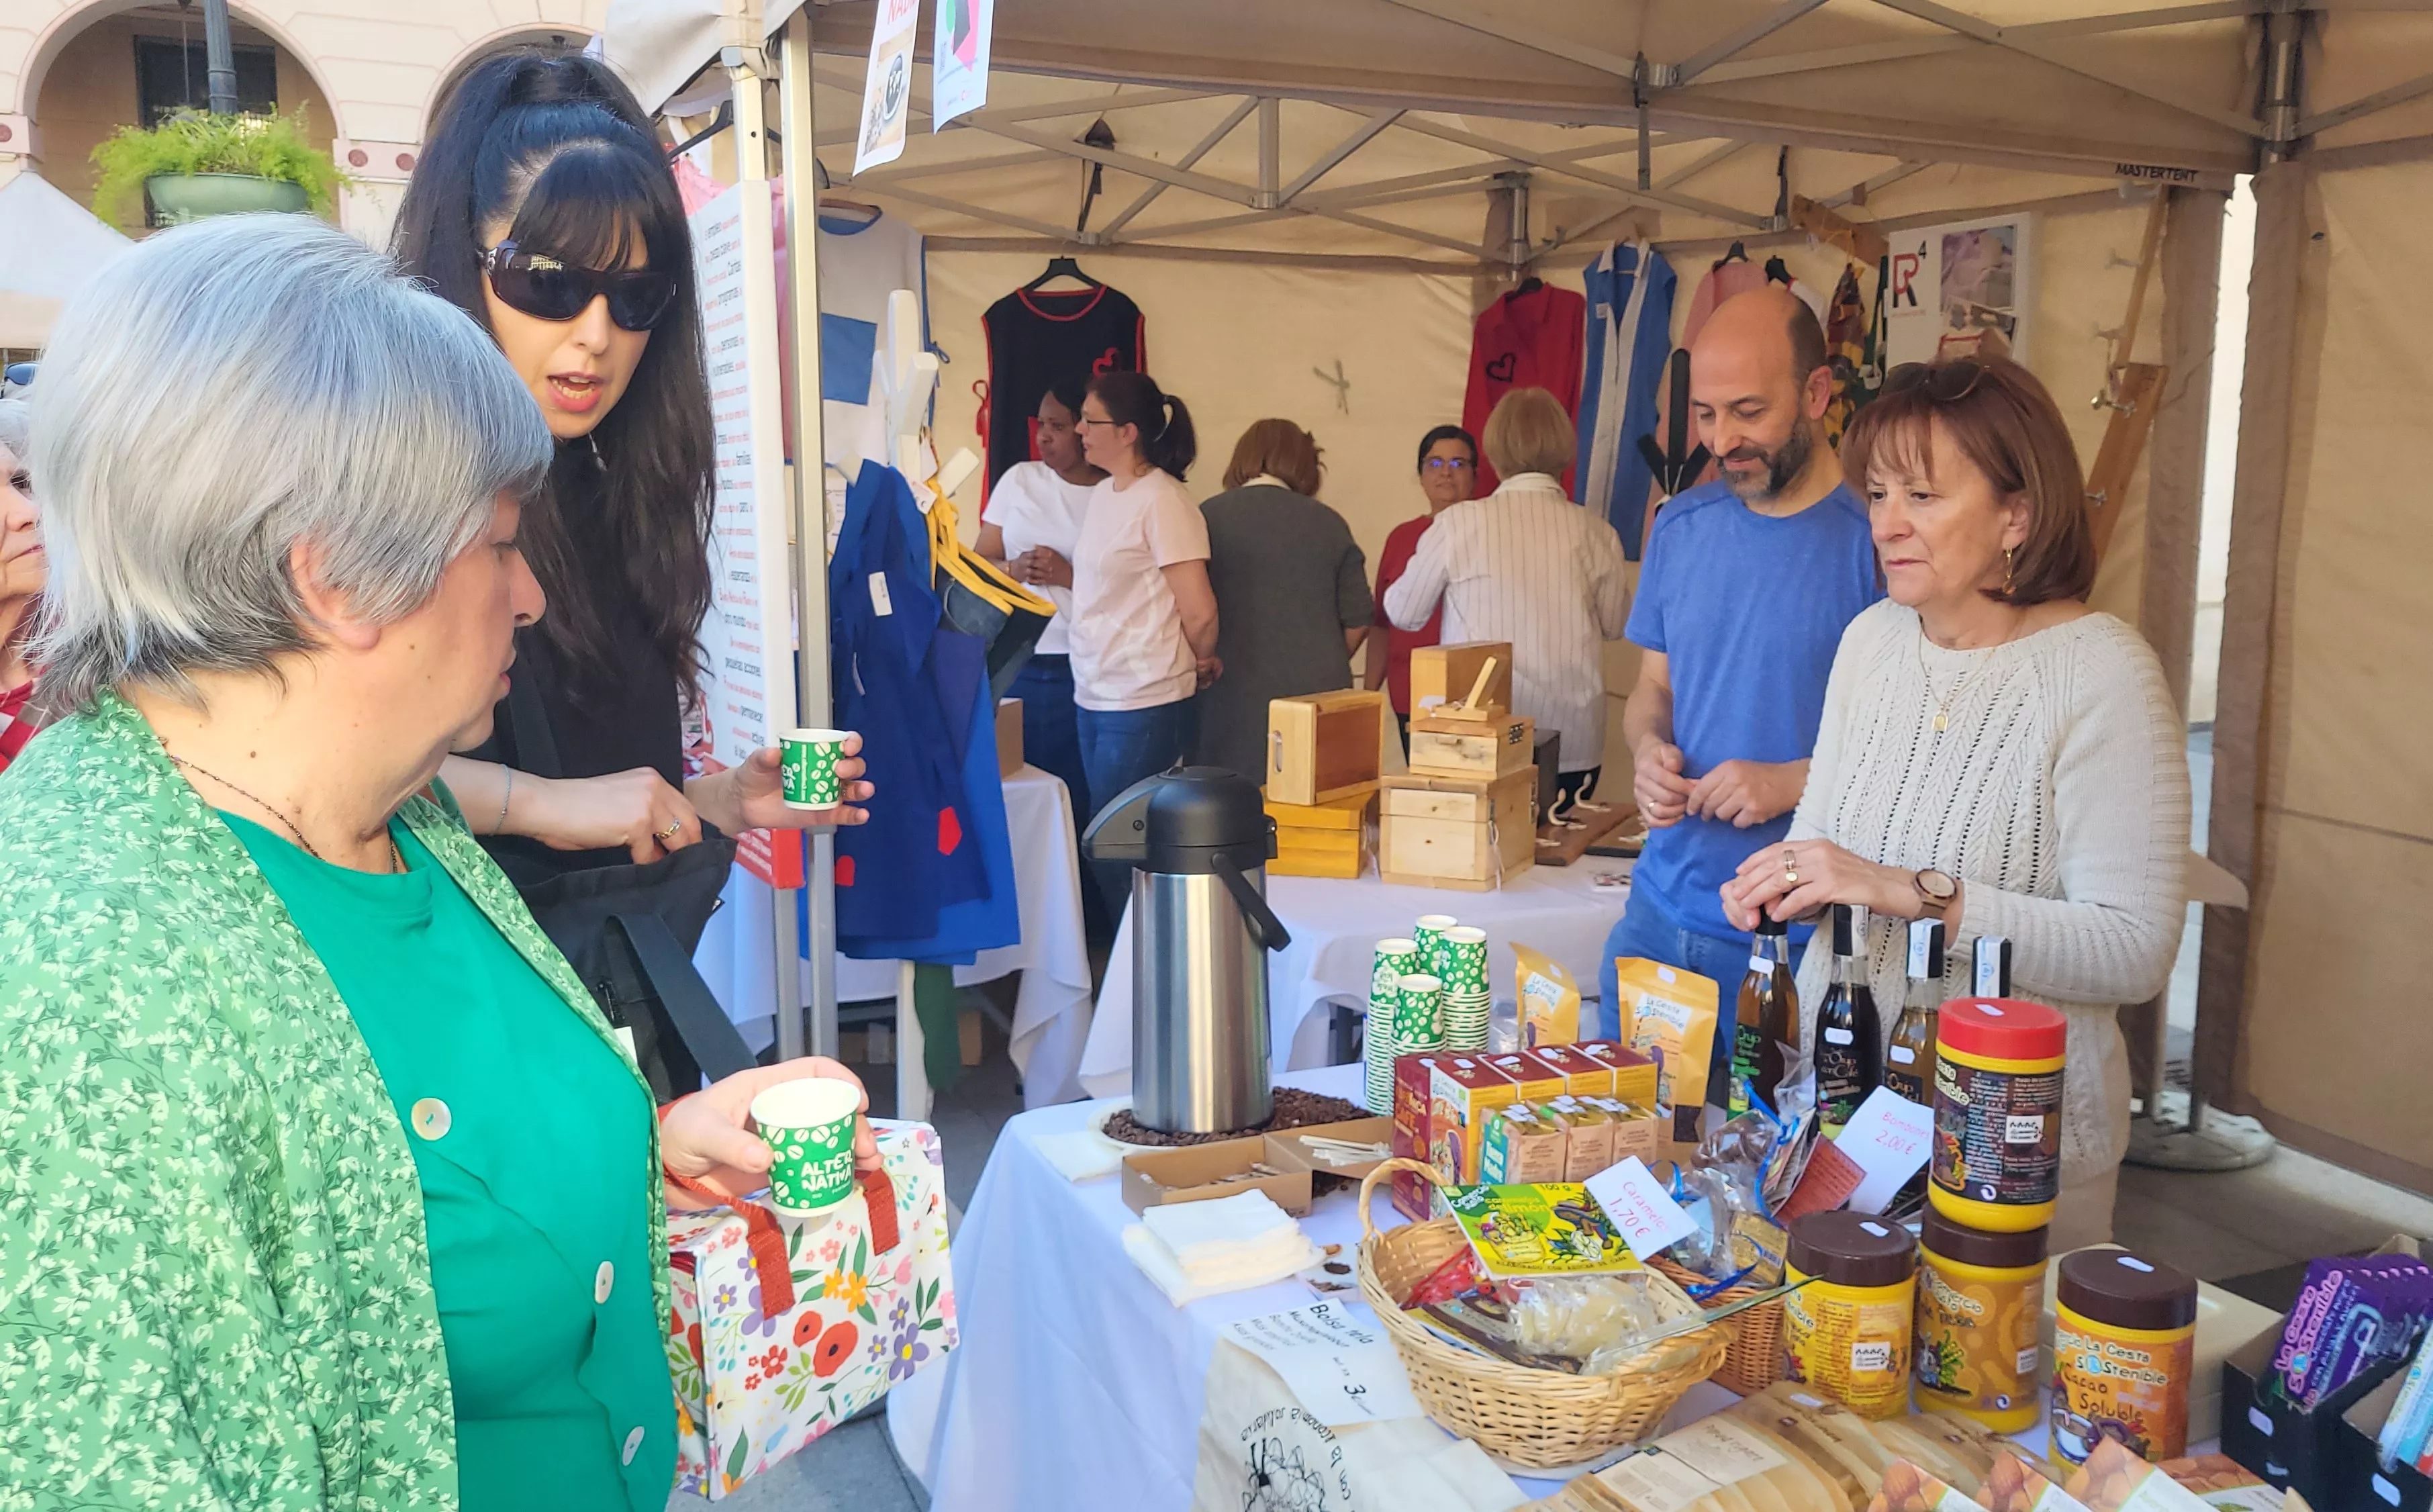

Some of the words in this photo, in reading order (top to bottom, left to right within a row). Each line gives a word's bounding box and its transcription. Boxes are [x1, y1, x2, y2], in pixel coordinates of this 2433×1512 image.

[2115, 163, 2199, 183] MASTERTENT
[801, 1149, 853, 1178] ALTER
[802, 1164, 851, 1192] NATIVA
[2085, 1334, 2100, 1352] La
[2106, 1343, 2150, 1363] Cesta
[2064, 1363, 2107, 1394] Cacao
[2079, 1392, 2144, 1421] Soluble
